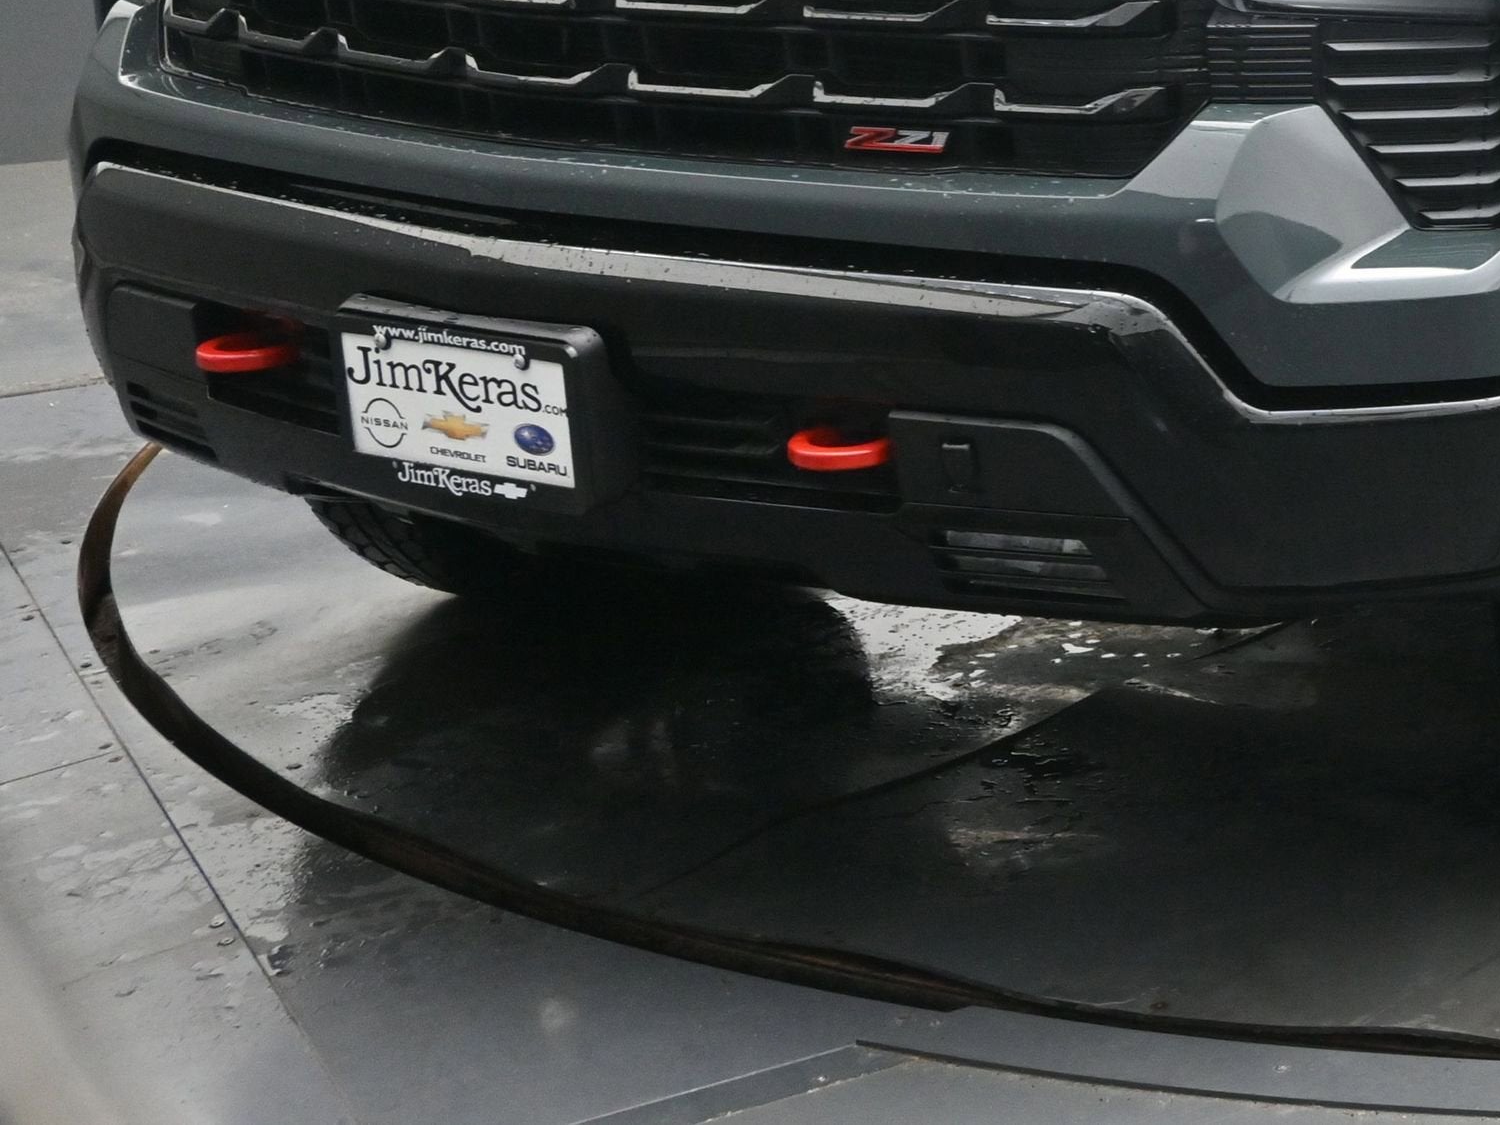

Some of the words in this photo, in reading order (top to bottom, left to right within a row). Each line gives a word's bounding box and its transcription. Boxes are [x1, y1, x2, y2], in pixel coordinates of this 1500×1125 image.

[844, 126, 950, 153] Z71
[360, 415, 409, 431] NISSAN
[429, 446, 487, 463] CHEVROLET
[506, 455, 568, 476] SUBARU
